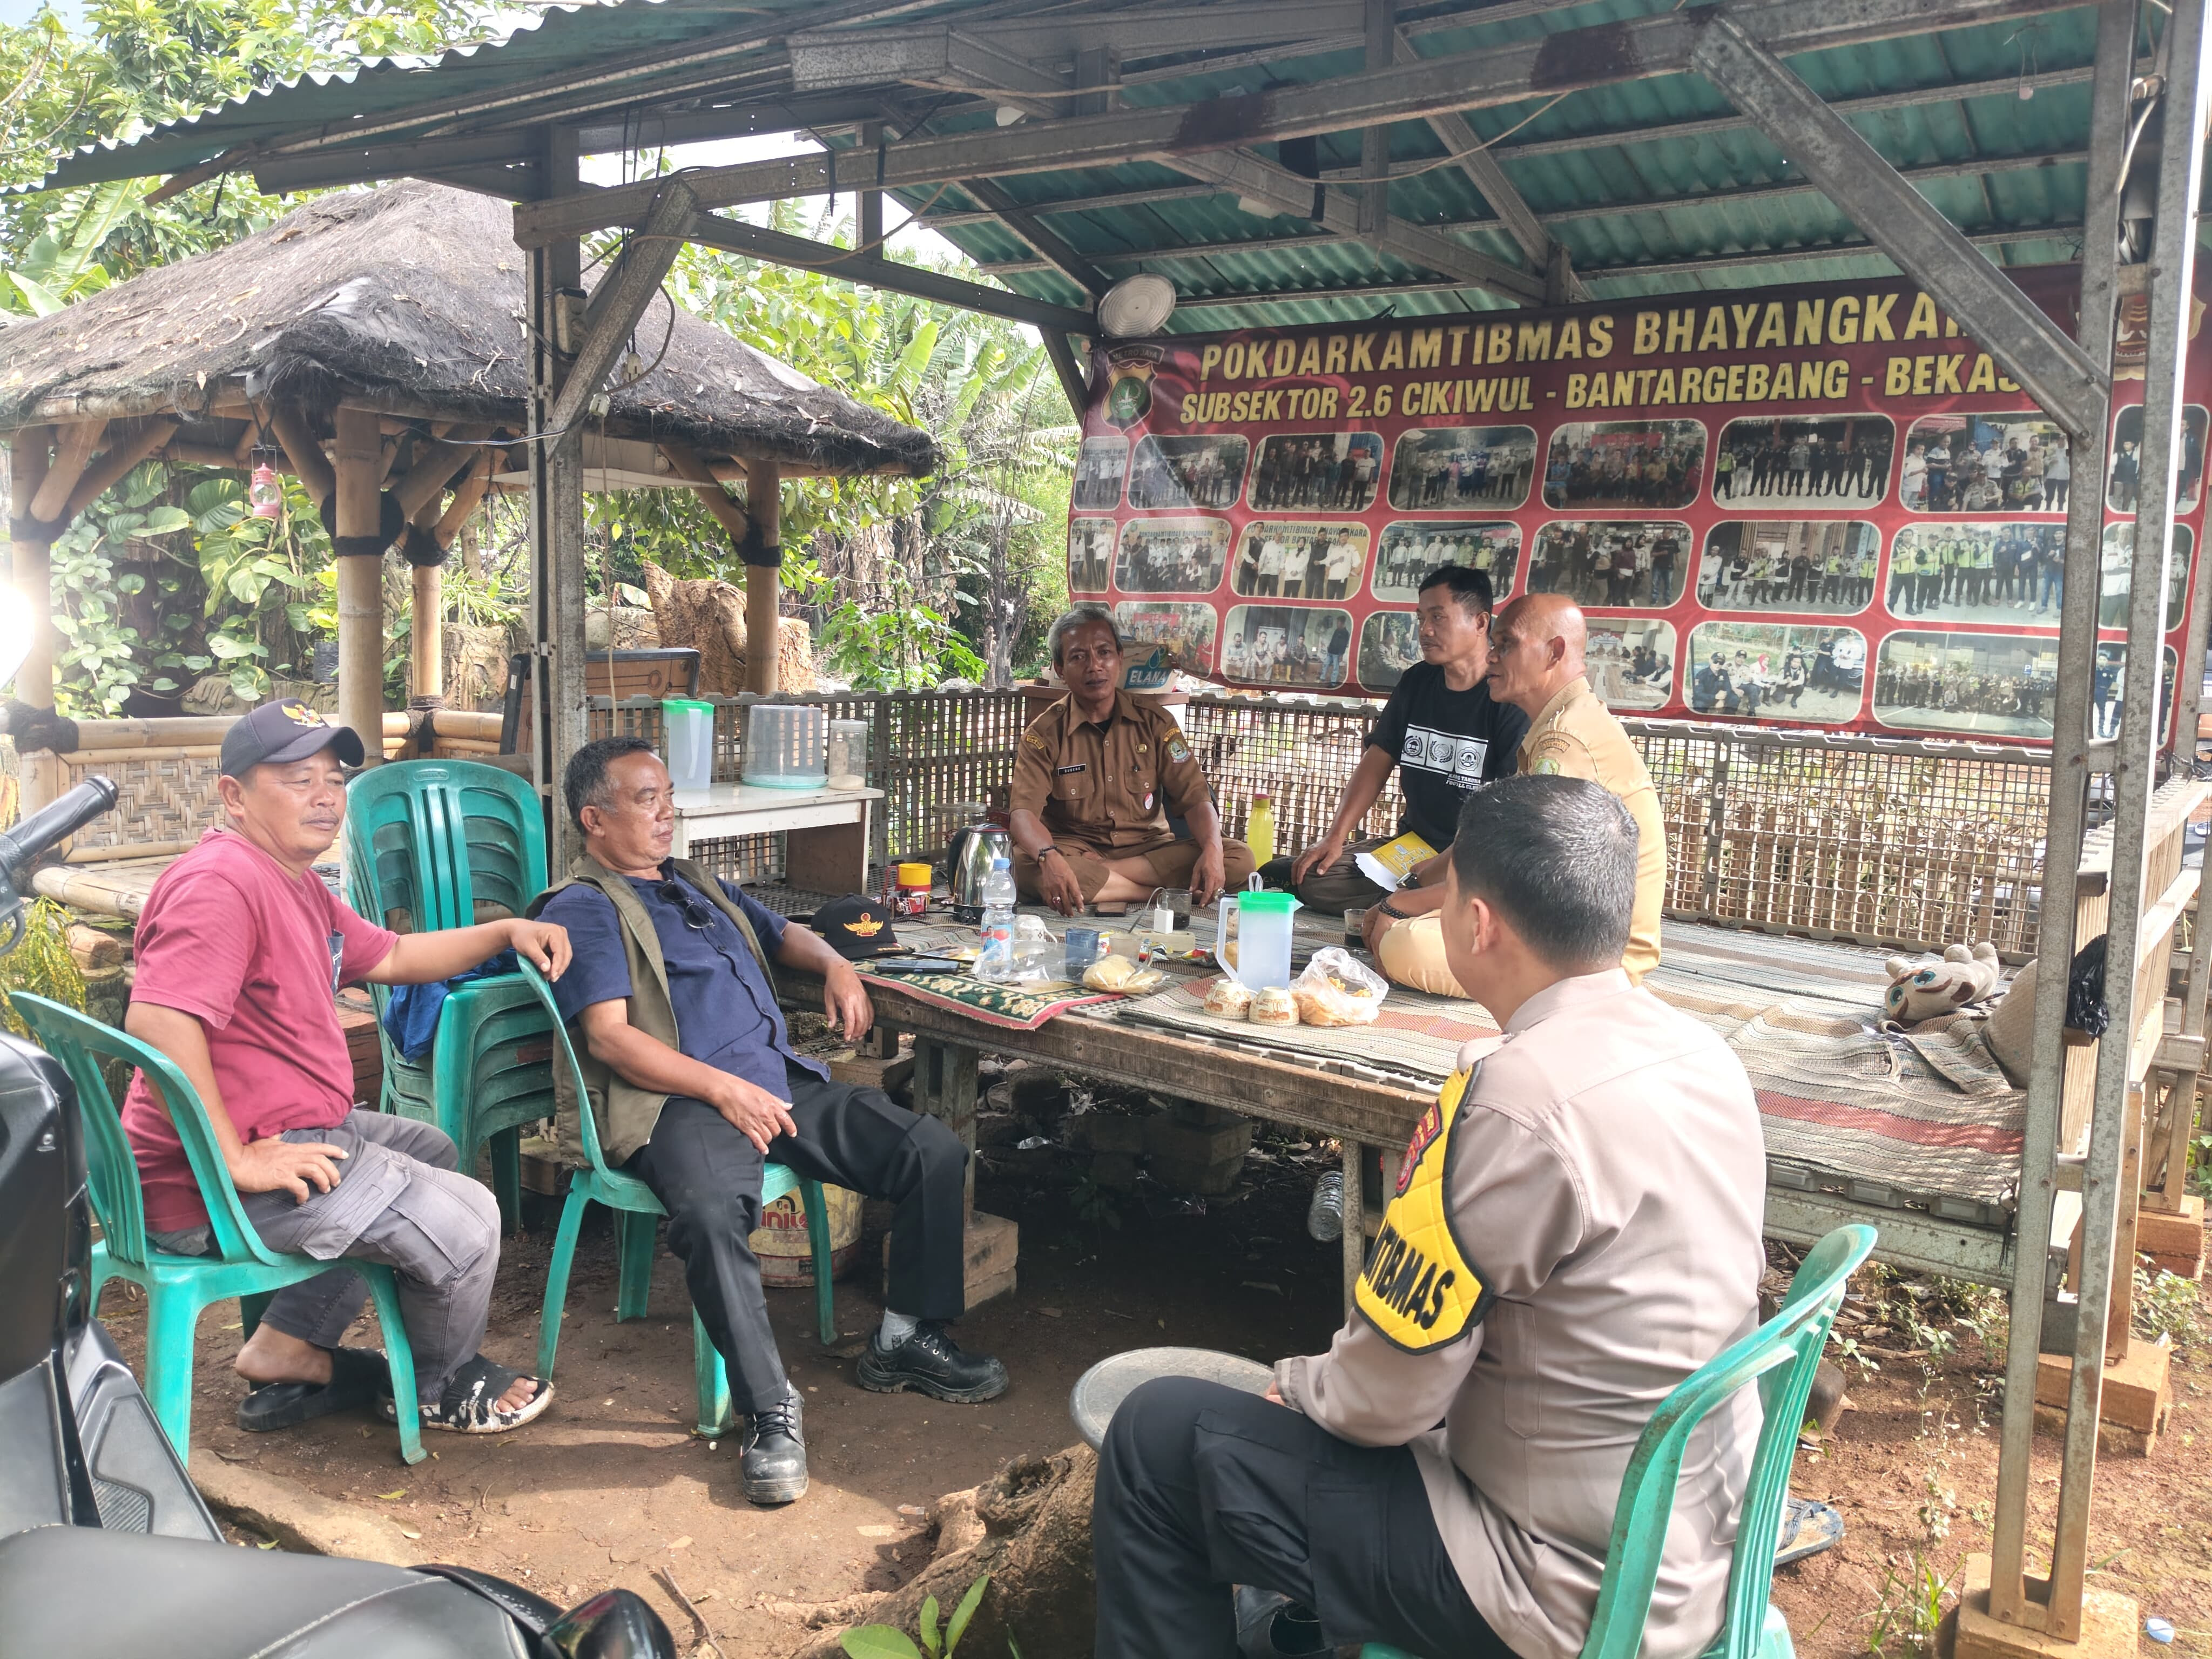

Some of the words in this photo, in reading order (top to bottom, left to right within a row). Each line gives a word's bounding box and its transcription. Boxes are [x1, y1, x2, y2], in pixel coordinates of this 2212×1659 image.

[1201, 316, 1614, 381] POKDARKAMTIBMAS
[1181, 387, 1339, 424] SUBSEKTOR
[1346, 385, 1393, 418] 2.6
[1401, 377, 1533, 415] CIKIWUL
[1566, 360, 1850, 412] BANTARGEBANG
[1129, 670, 1167, 685] ELANA
